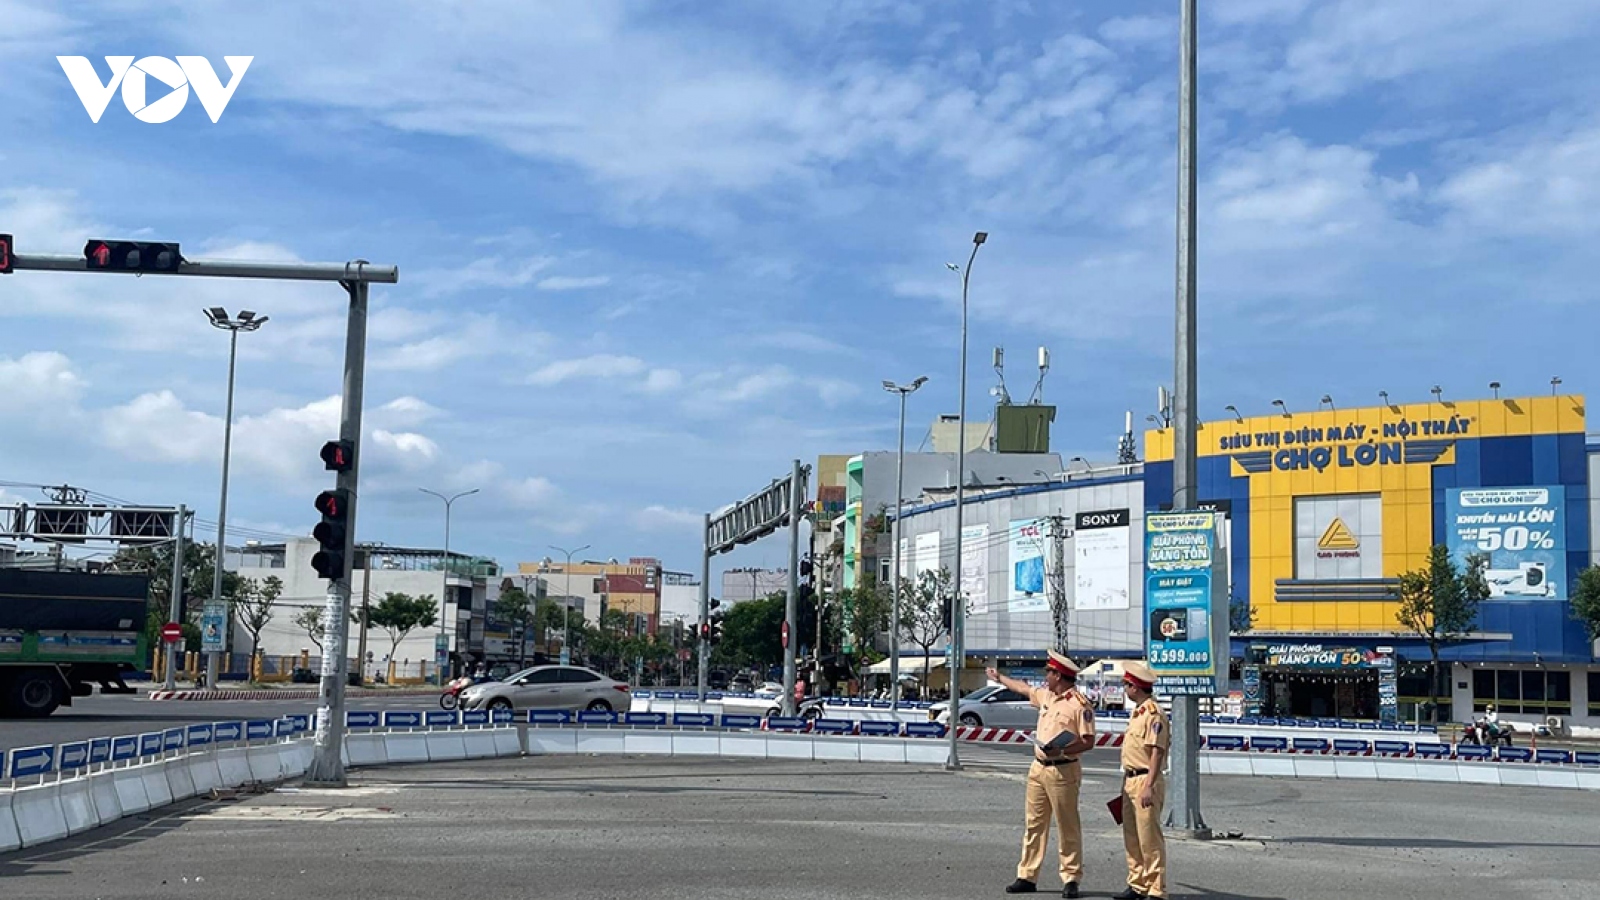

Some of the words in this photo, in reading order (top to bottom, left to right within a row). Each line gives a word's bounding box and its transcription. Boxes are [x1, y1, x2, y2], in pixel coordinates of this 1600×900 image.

[1255, 431, 1280, 451] THỊ
[1283, 426, 1323, 446] ĐIỆN
[1326, 422, 1366, 441] MÁY
[1383, 419, 1417, 440] NỘI
[1274, 446, 1332, 473] CHỢ
[1337, 439, 1400, 467] LỚN
[1082, 513, 1121, 526] SONY
[1517, 507, 1555, 523] LỚN
[1020, 526, 1039, 537] TCL
[1477, 526, 1554, 551] 50%
[1150, 649, 1208, 663] 3.599.000
